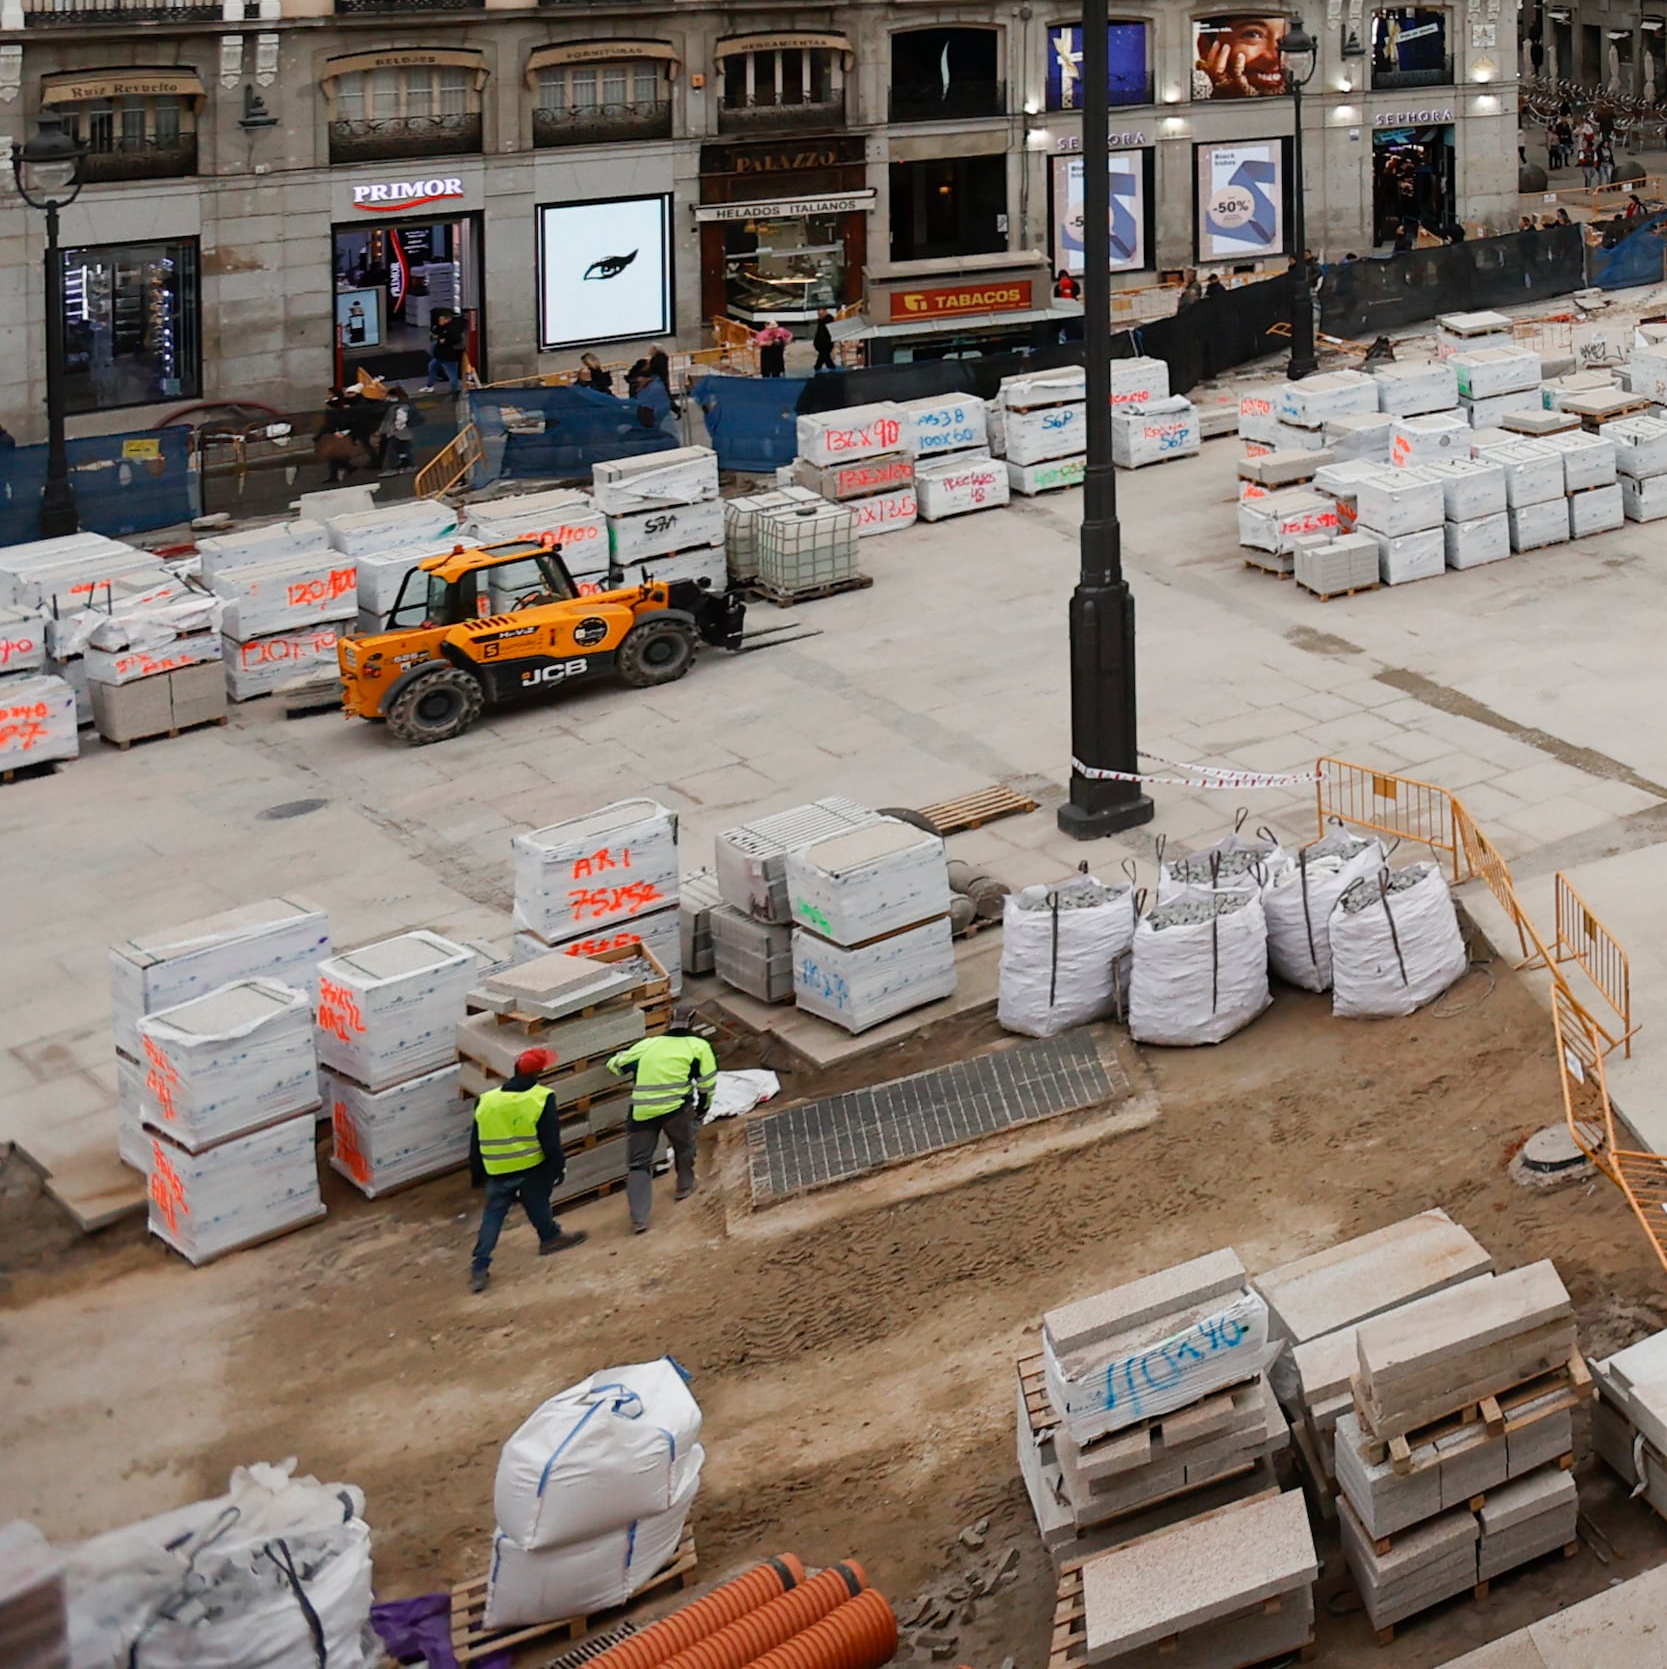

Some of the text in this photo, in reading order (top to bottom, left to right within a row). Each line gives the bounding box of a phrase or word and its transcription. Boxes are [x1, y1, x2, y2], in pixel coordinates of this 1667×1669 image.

[71, 85, 107, 99] Ruiz
[1375, 110, 1452, 125] SEPHORA
[1057, 131, 1146, 151] SEORA
[735, 150, 837, 173] PALAZZO
[353, 178, 463, 203] PRIMOR
[716, 199, 857, 220] HELADOS ITALIANOS
[935, 288, 1021, 310] TABACOS
[522, 658, 588, 687] JCB
